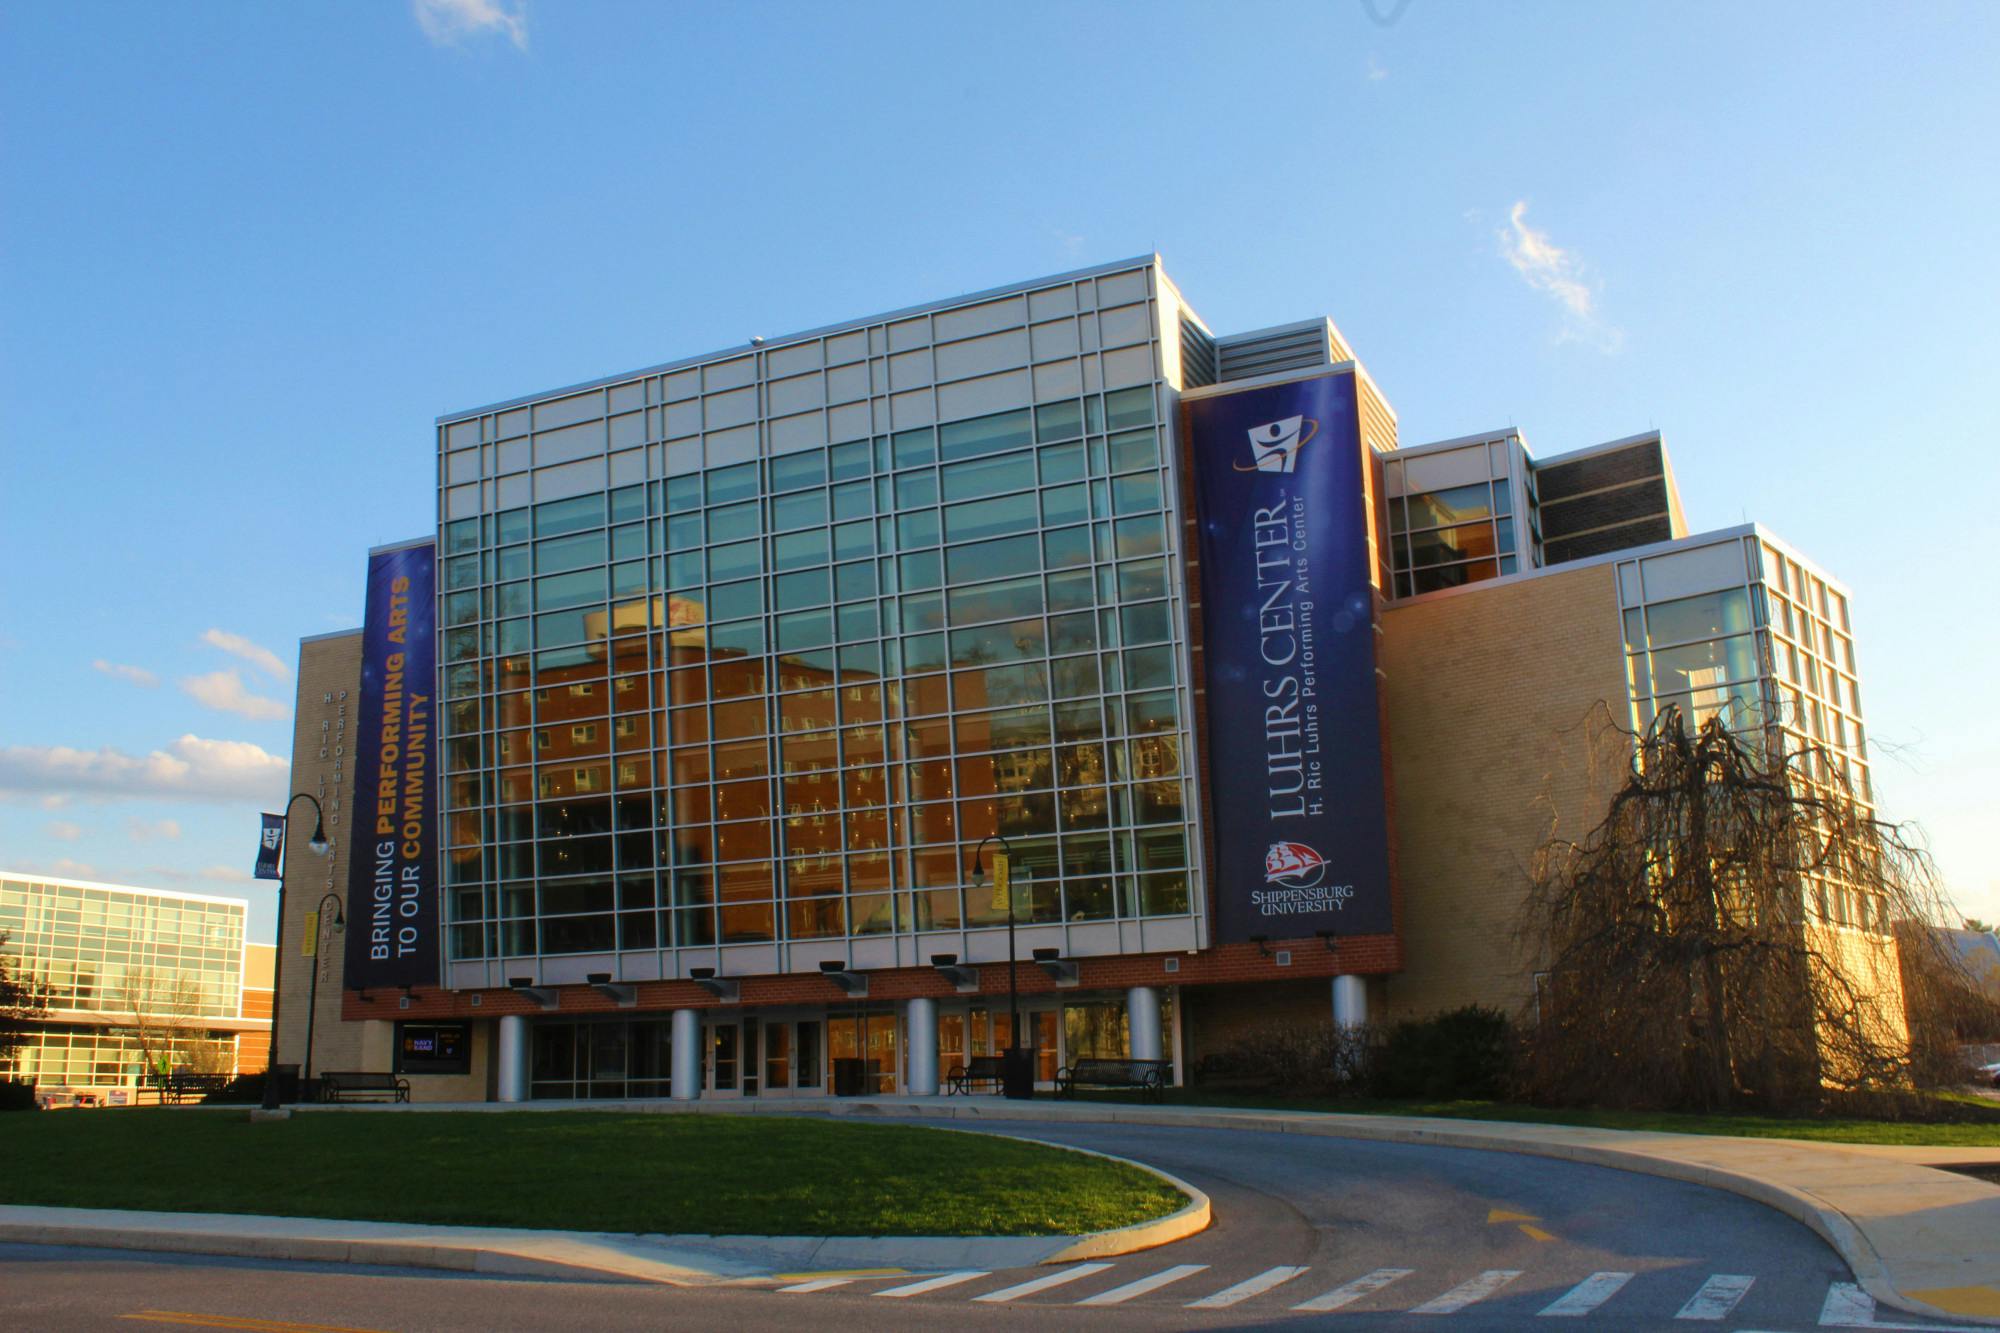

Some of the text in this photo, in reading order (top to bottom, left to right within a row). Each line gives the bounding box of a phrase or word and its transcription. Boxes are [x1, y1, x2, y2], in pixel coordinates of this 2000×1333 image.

[320, 719, 329, 758] RIC
[370, 575, 410, 960] BRINGING PERFORMING ARTS
[1254, 499, 1305, 819] LUHRS CENTER
[1293, 496, 1323, 816] H. Ric Luhrs Performing Arts Center
[320, 690, 347, 982] PERFORMING ARTS CENTER
[397, 693, 428, 958] TO OUR COMMUNITY
[1251, 885, 1354, 905] SHIPPENSBURG
[1261, 898, 1345, 916] UNIVERSITY
